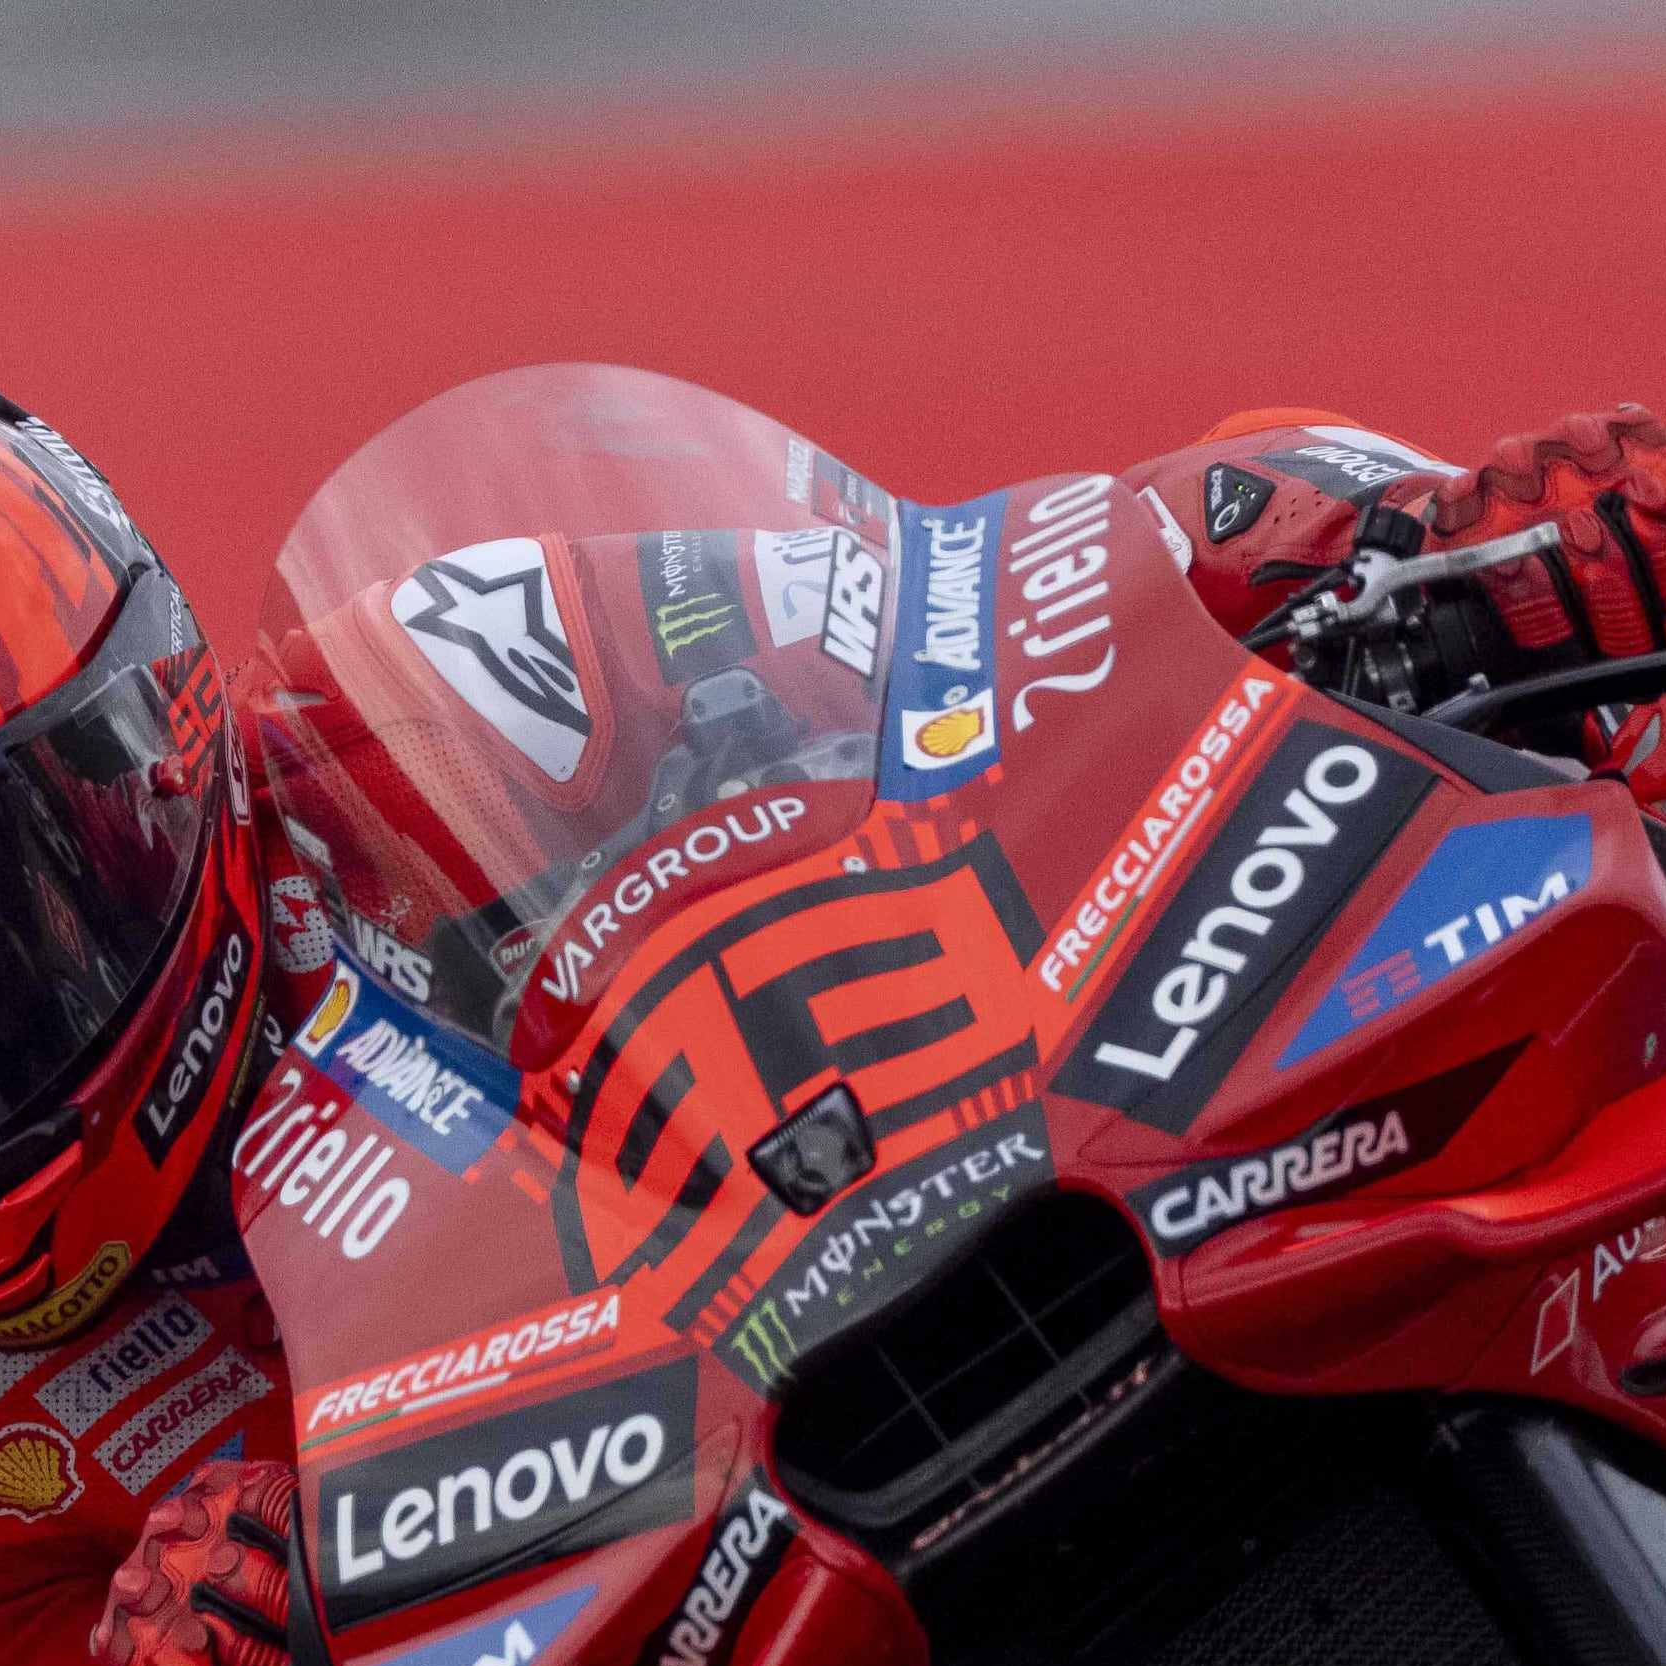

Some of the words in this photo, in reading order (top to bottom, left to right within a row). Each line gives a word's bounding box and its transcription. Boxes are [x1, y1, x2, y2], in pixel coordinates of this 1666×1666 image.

[659, 531, 685, 597] MONSTE
[824, 532, 883, 677] WRS
[914, 516, 987, 671] ADVANCE
[541, 796, 807, 1000] VARGROUP
[1040, 678, 1277, 992] FRECCIAROSSA
[351, 914, 433, 1001] WRS
[1094, 743, 1378, 1082] Lenovo
[1423, 871, 1570, 966] TIM
[148, 933, 242, 1136] Lenovo
[336, 1018, 484, 1136] ADVANCE
[1151, 1111, 1410, 1241] CARRERA
[838, 1185, 1013, 1307] ENERGY
[111, 1364, 251, 1473] CARRERA
[307, 1295, 621, 1431] FRECCIAROSSA
[337, 1413, 663, 1584] Lenovo
